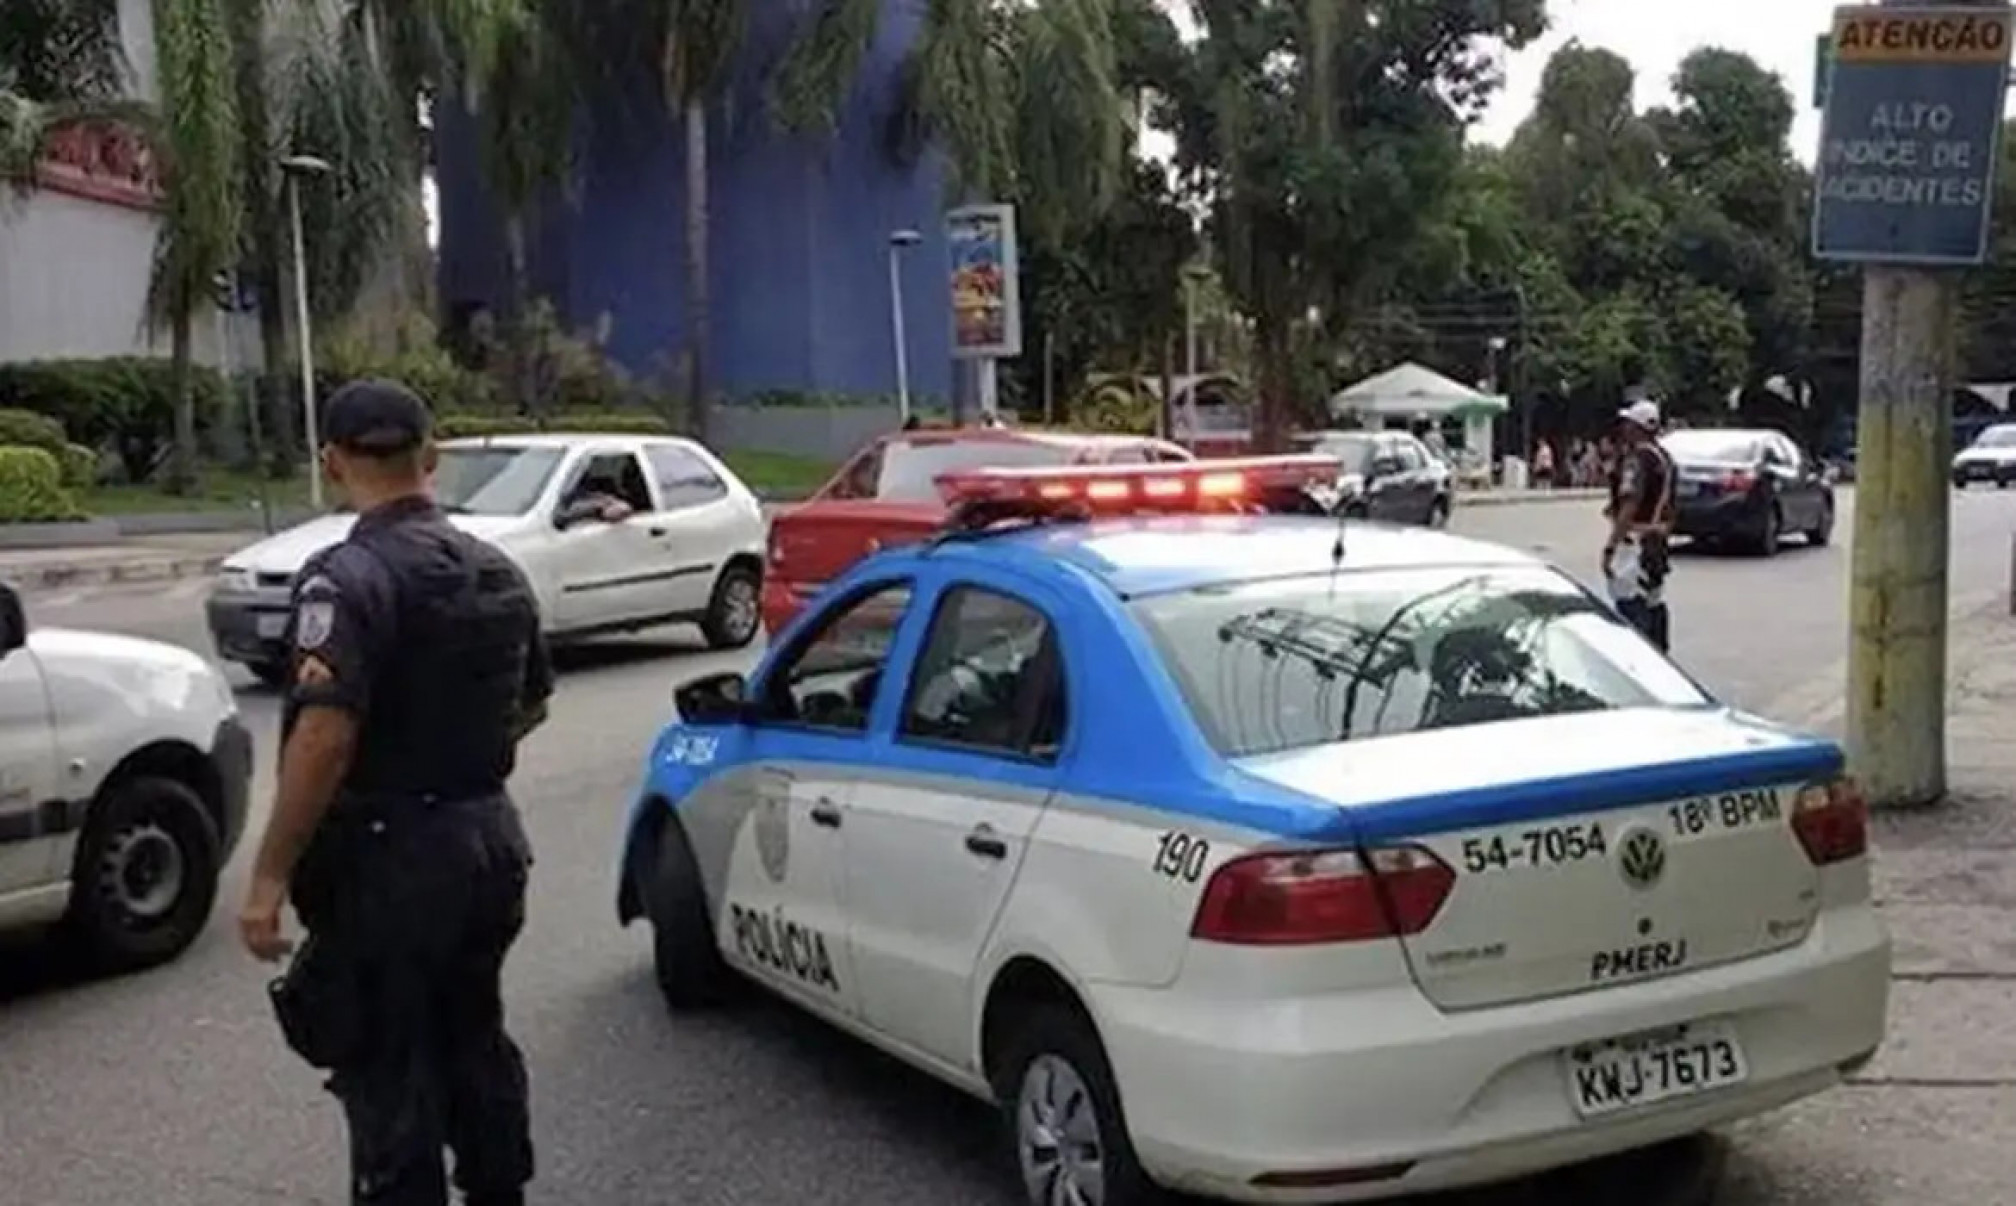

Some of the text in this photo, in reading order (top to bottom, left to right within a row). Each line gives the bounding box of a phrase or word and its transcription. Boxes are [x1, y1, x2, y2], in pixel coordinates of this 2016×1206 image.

[1871, 103, 1954, 132] ALTO
[1933, 141, 1971, 168] DE
[1720, 788, 1780, 828] BPM
[1153, 830, 1209, 882] 190
[1462, 822, 1607, 873] 54-7054
[1592, 939, 1687, 980] PMERJ
